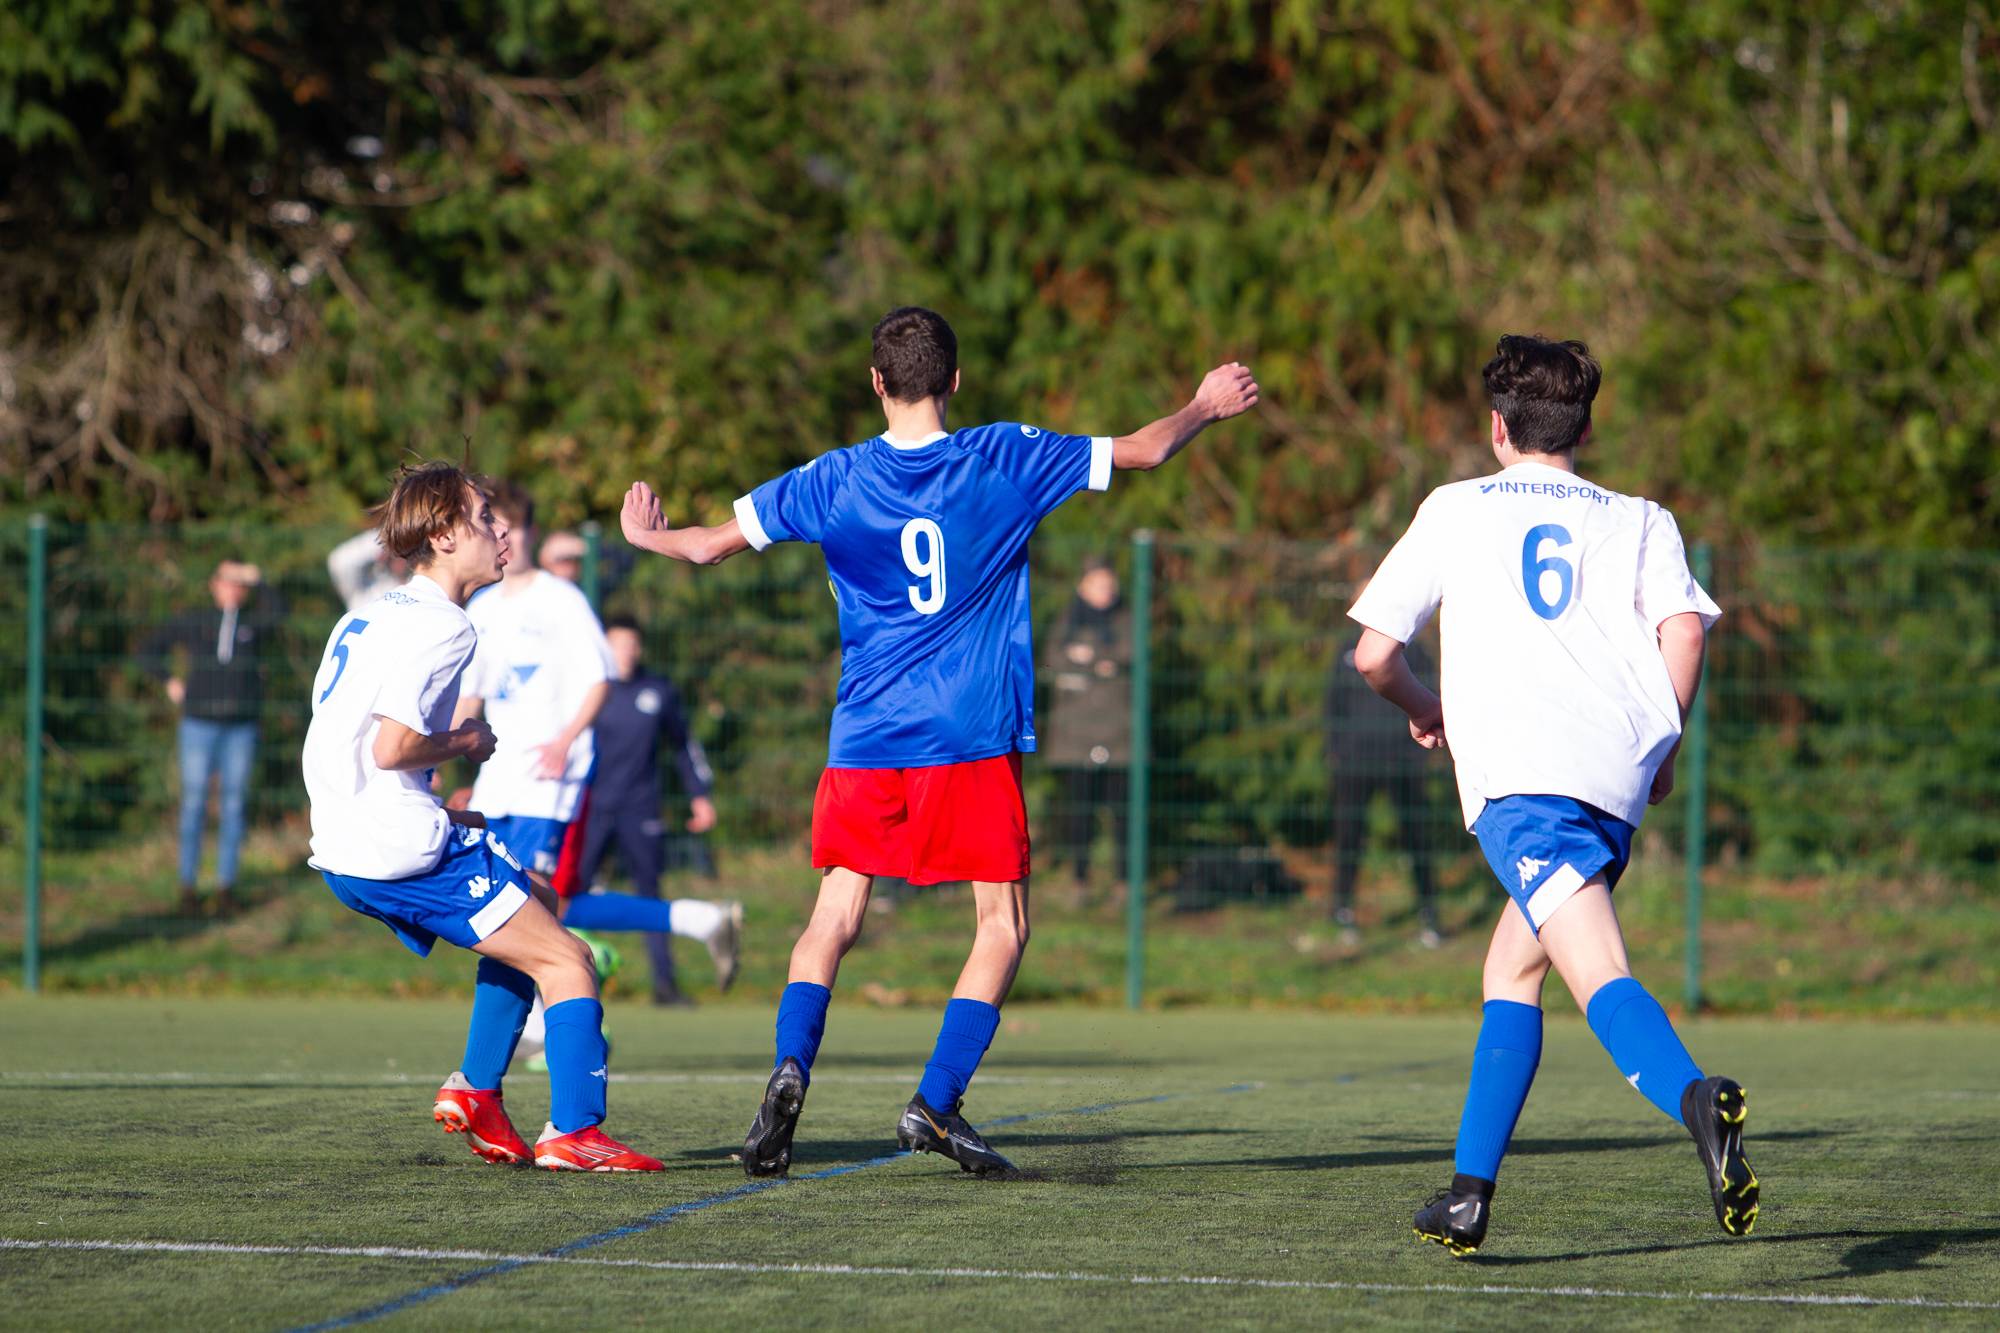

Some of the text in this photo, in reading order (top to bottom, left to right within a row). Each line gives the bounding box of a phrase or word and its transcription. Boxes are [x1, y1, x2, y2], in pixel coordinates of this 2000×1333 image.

[1499, 481, 1612, 506] INTERSPORT
[900, 517, 946, 615] 9
[1522, 523, 1573, 620] 6
[318, 618, 369, 704] 5
